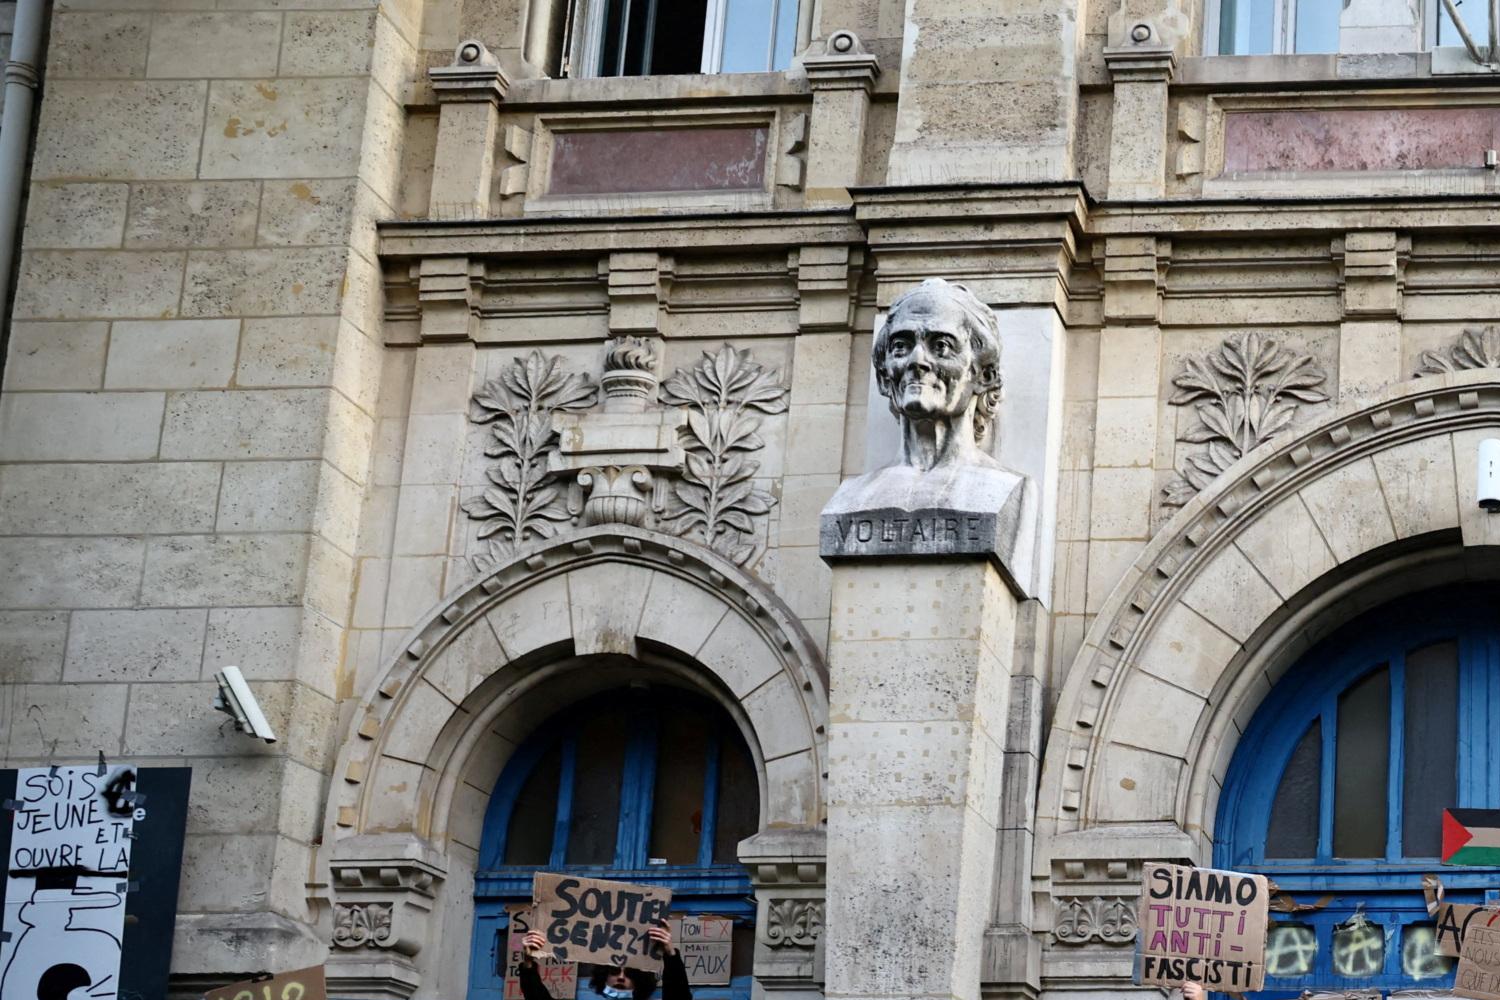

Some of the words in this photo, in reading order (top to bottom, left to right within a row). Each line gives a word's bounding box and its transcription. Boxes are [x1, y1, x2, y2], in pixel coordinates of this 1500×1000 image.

[836, 517, 981, 543] VOLTAIRE
[17, 800, 104, 834] JEUNE
[96, 823, 123, 844] ET
[98, 848, 129, 870] LA
[684, 923, 701, 937] TON
[1472, 928, 1496, 946] ILS
[684, 955, 729, 977] FAUX
[1462, 947, 1500, 968] NOUS
[1461, 969, 1487, 991] QUE
